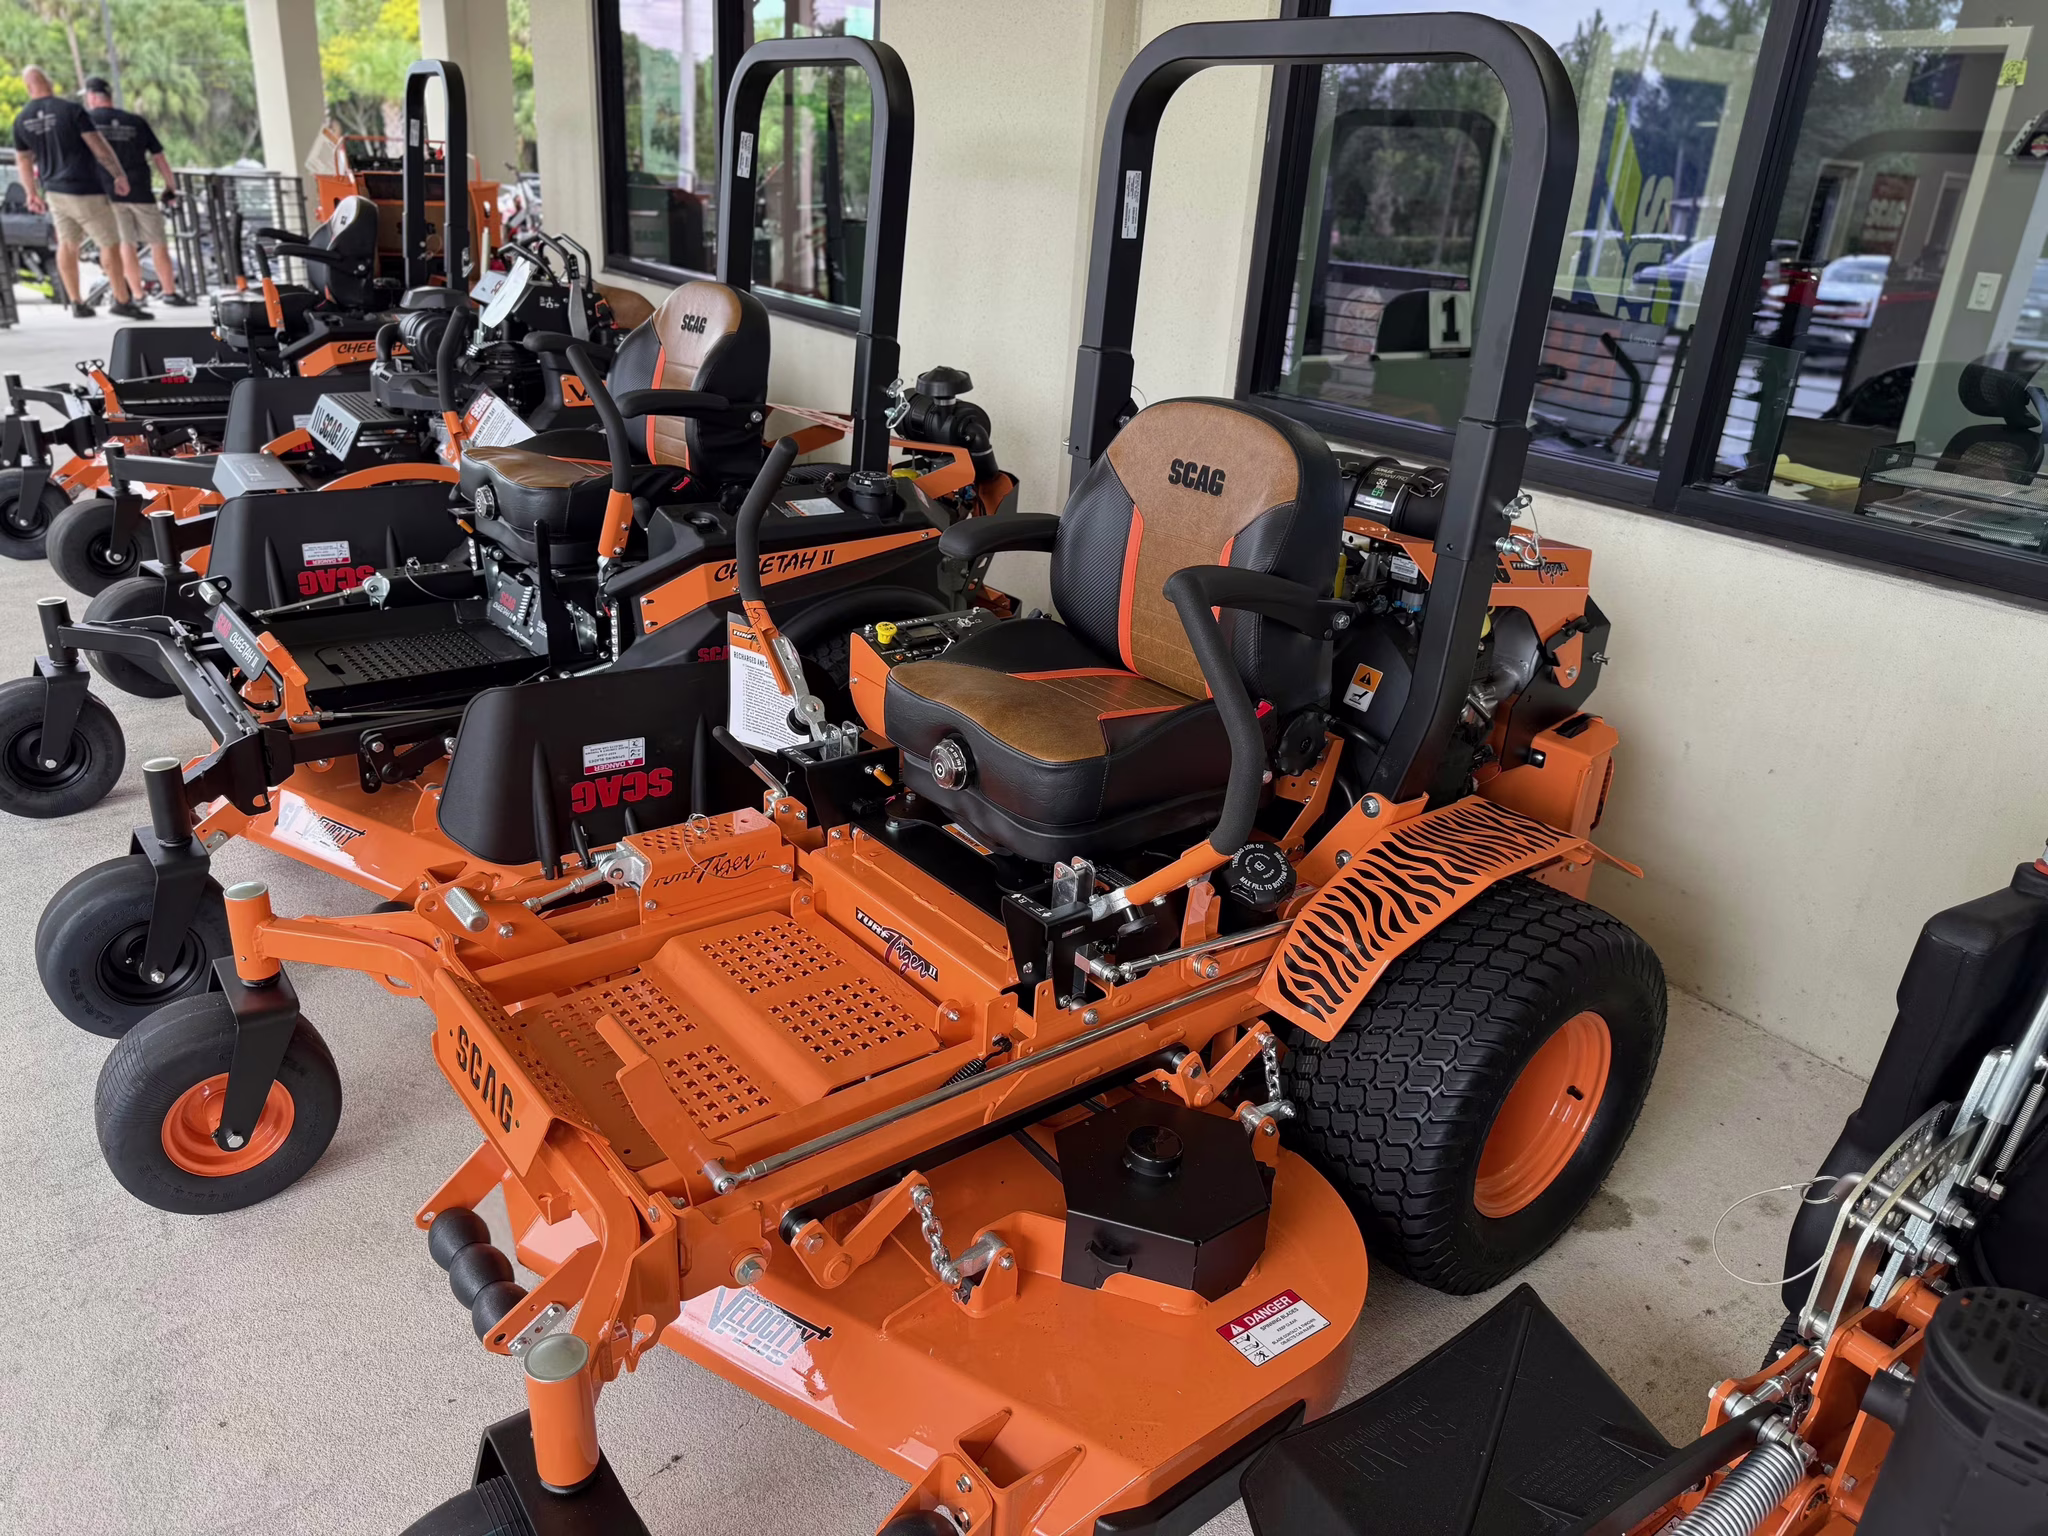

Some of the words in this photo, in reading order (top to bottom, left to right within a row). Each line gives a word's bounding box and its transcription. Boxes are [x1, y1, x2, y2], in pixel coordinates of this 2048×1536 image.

[681, 314, 707, 334] SCAG
[1443, 295, 1460, 341] 1
[337, 341, 402, 354] CHEEH
[319, 413, 343, 446] SCAG
[1168, 458, 1226, 497] SCAG
[1371, 488, 1385, 497] EFI
[821, 549, 836, 566] II
[298, 565, 375, 596] SCAG
[229, 631, 256, 664] CHEETAH
[698, 646, 730, 663] SCA
[594, 761, 626, 771] DANGER
[571, 767, 672, 813] SCAG
[1243, 843, 1256, 851] NOT
[1240, 876, 1252, 888] MAX
[1251, 882, 1264, 891] FILL
[1272, 871, 1288, 888] BOTTOM
[857, 910, 891, 939] TURF
[882, 926, 929, 979] Tiger
[456, 1024, 515, 1134] SCAG
[708, 1284, 817, 1355] VELOCITY
[1243, 1295, 1293, 1327] DANGER
[1260, 1316, 1282, 1331] SPINNING
[1280, 1307, 1299, 1320] BLADES
[1276, 1324, 1286, 1332] KEEP
[1285, 1318, 1298, 1327] CLEAR
[715, 1321, 788, 1366] PLUS
